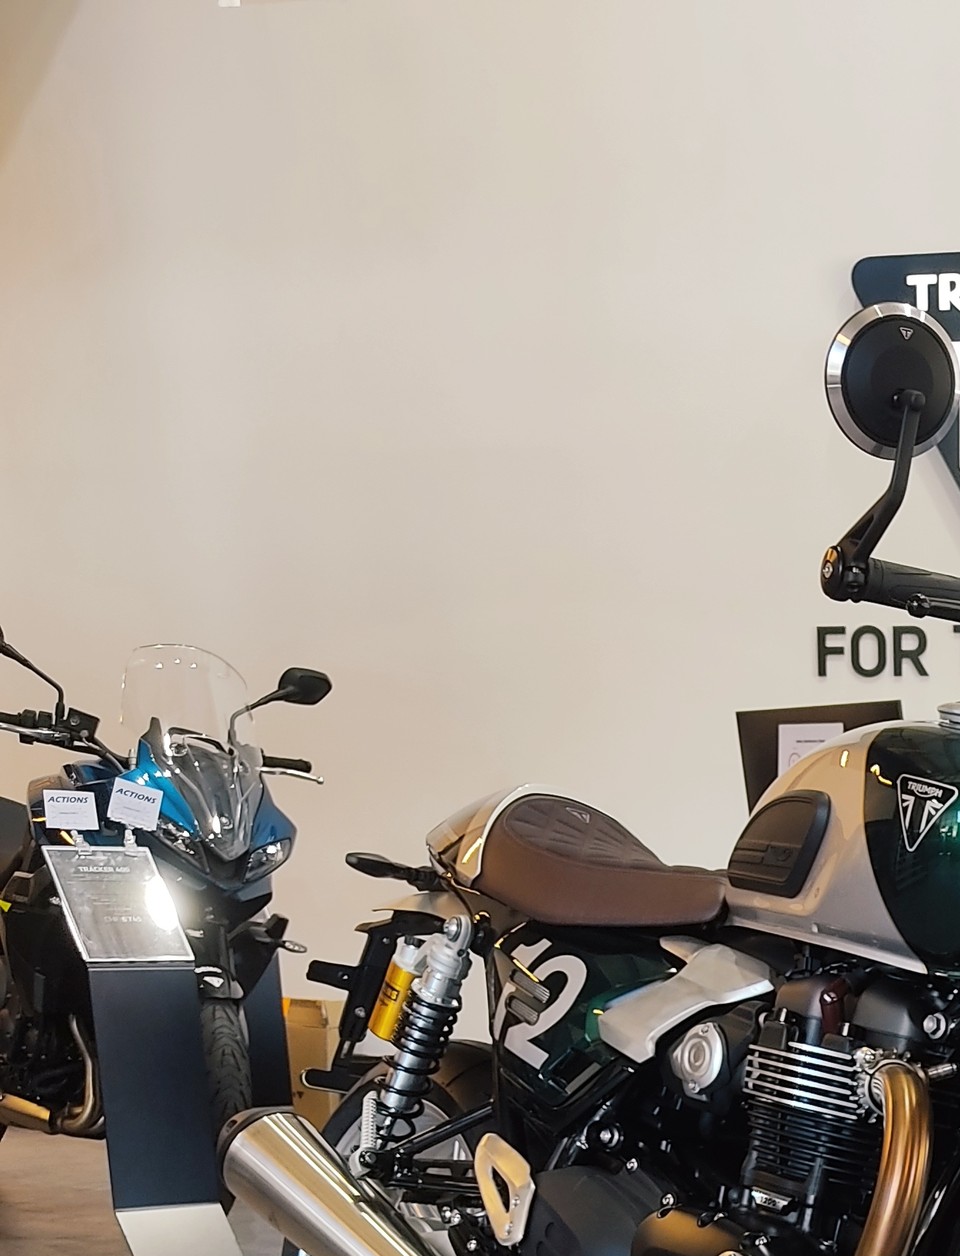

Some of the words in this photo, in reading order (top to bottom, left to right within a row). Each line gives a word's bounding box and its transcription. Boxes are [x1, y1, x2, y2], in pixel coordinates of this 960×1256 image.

[816, 625, 929, 676] FOR
[116, 788, 157, 804] ACTIONS
[907, 781, 943, 798] TRIUMPH
[48, 796, 89, 804] ACTIONS
